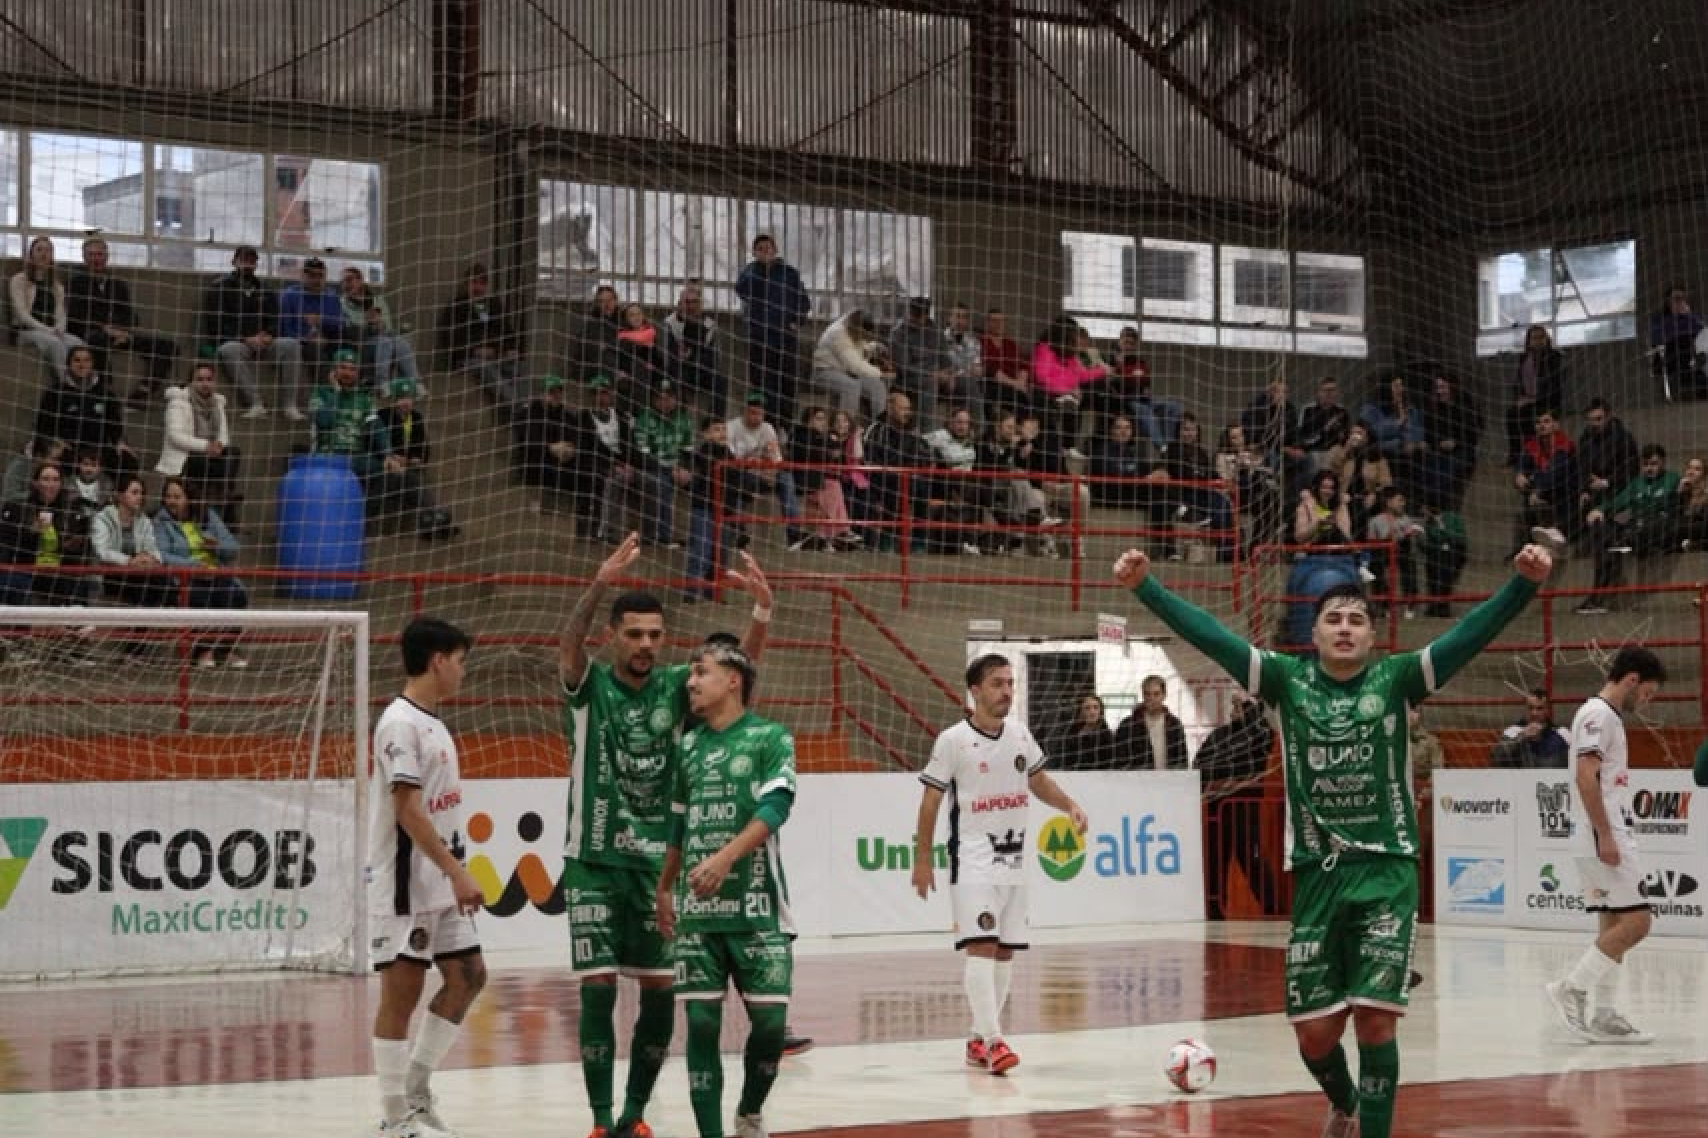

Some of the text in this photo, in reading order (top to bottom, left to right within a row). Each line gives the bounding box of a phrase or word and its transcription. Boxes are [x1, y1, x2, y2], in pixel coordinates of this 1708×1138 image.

[1094, 814, 1181, 878] alfa
[50, 828, 318, 894] SICOOB
[745, 891, 772, 918] 20
[1526, 893, 1585, 911] centes
[1650, 900, 1703, 918] quinas
[111, 898, 309, 935] MaxiCrédito
[574, 936, 594, 962] 10
